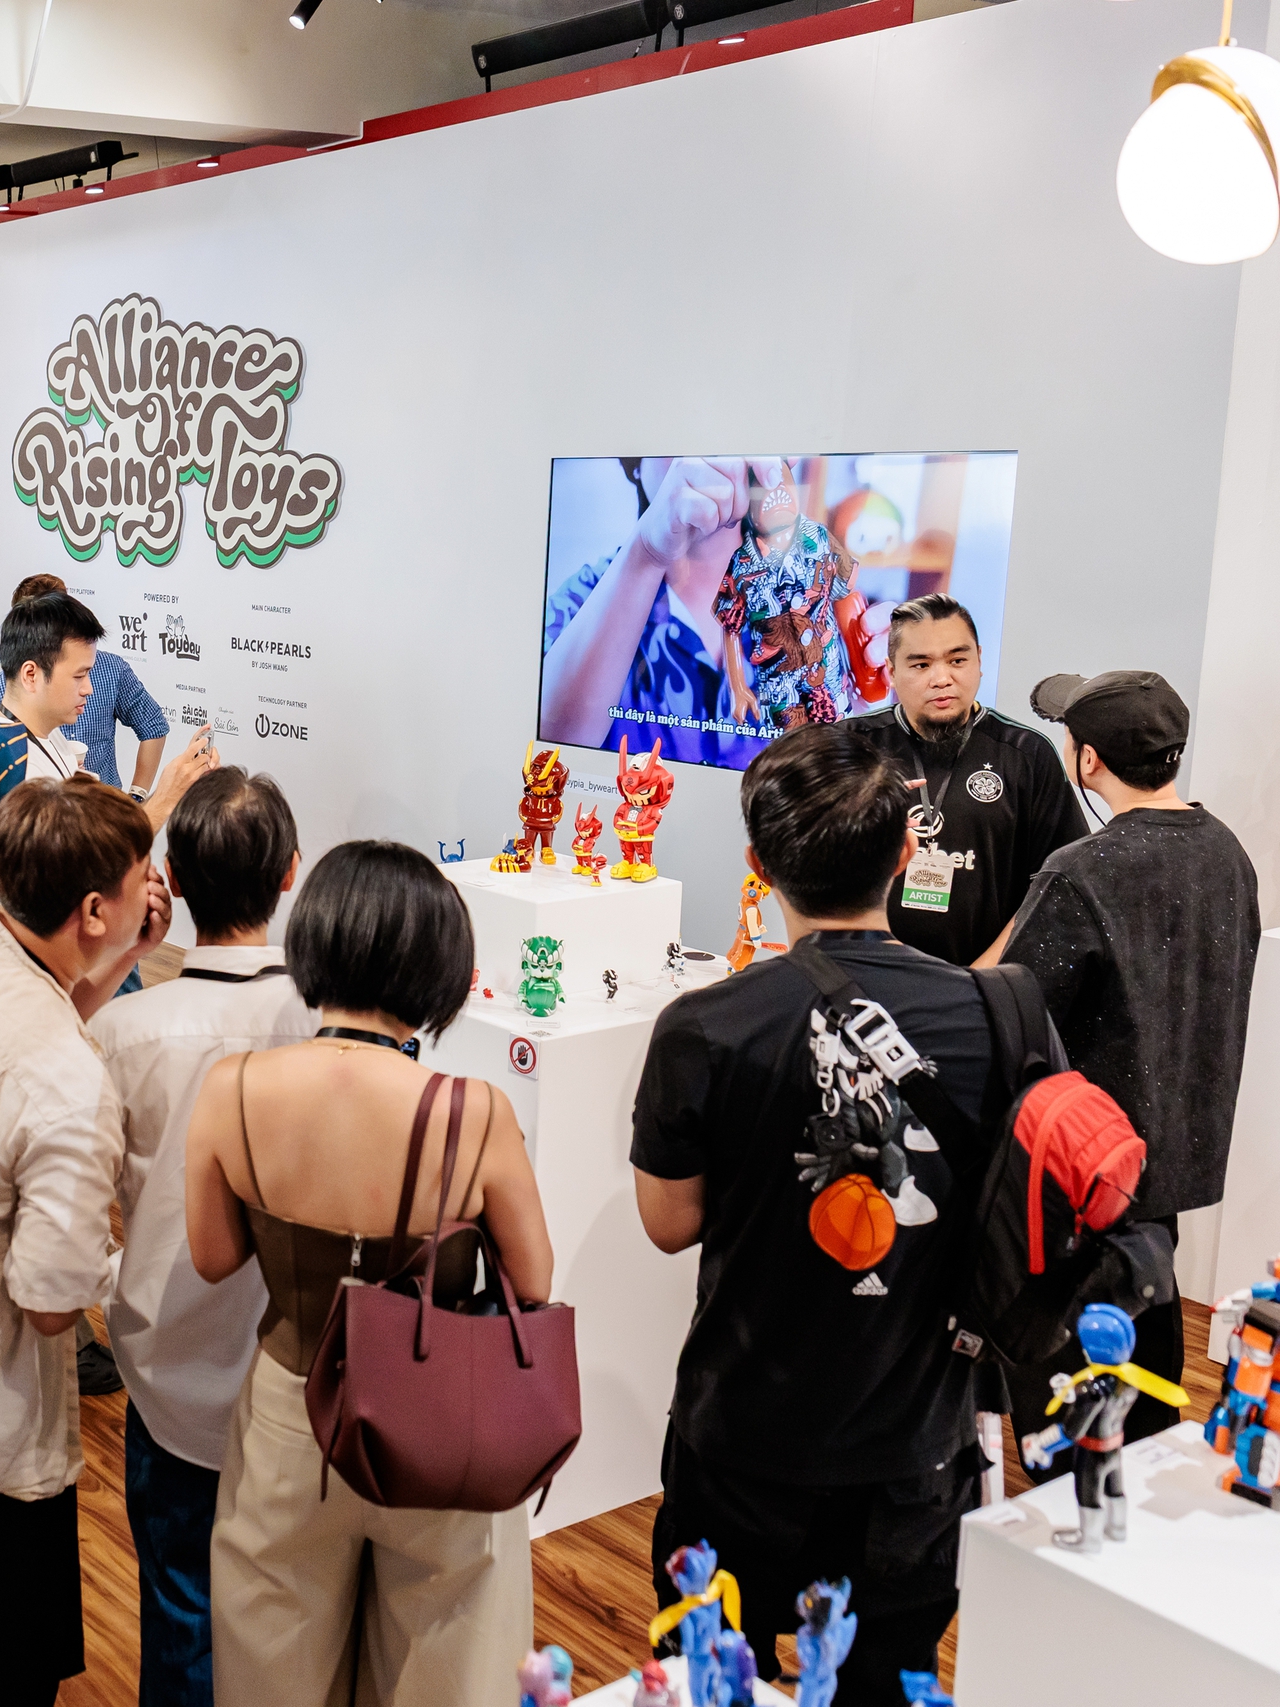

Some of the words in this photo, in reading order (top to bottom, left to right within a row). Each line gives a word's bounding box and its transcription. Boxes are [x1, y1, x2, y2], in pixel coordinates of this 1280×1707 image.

[51, 302, 296, 413] Alliance
[115, 391, 204, 458] Of
[16, 420, 179, 541] Rising
[196, 391, 332, 541] Toys
[143, 592, 171, 603] POWERED
[171, 595, 180, 604] BY
[251, 604, 264, 612] MAIN
[264, 605, 292, 614] CHARACTER
[118, 614, 143, 632] we
[121, 630, 148, 652] art
[231, 636, 264, 653] BLACK
[270, 641, 312, 659] PEARLS
[251, 660, 258, 668] BY
[258, 661, 272, 670] JOSH
[272, 663, 289, 672] WANG
[175, 683, 188, 691] MEDIA
[188, 685, 206, 694] PARTNER
[182, 703, 193, 715] SÀI
[193, 705, 208, 718] GÒN
[257, 695, 286, 706] TECHNOLOGY
[286, 699, 308, 709] PARTNER
[608, 706, 624, 719] thì
[624, 708, 645, 724] đây
[645, 710, 657, 723] là
[657, 713, 680, 728] một
[680, 715, 700, 729] sản
[701, 717, 734, 733] phẩm
[735, 721, 756, 737] của
[271, 721, 308, 741] ZONE
[909, 891, 943, 903] ARTIST
